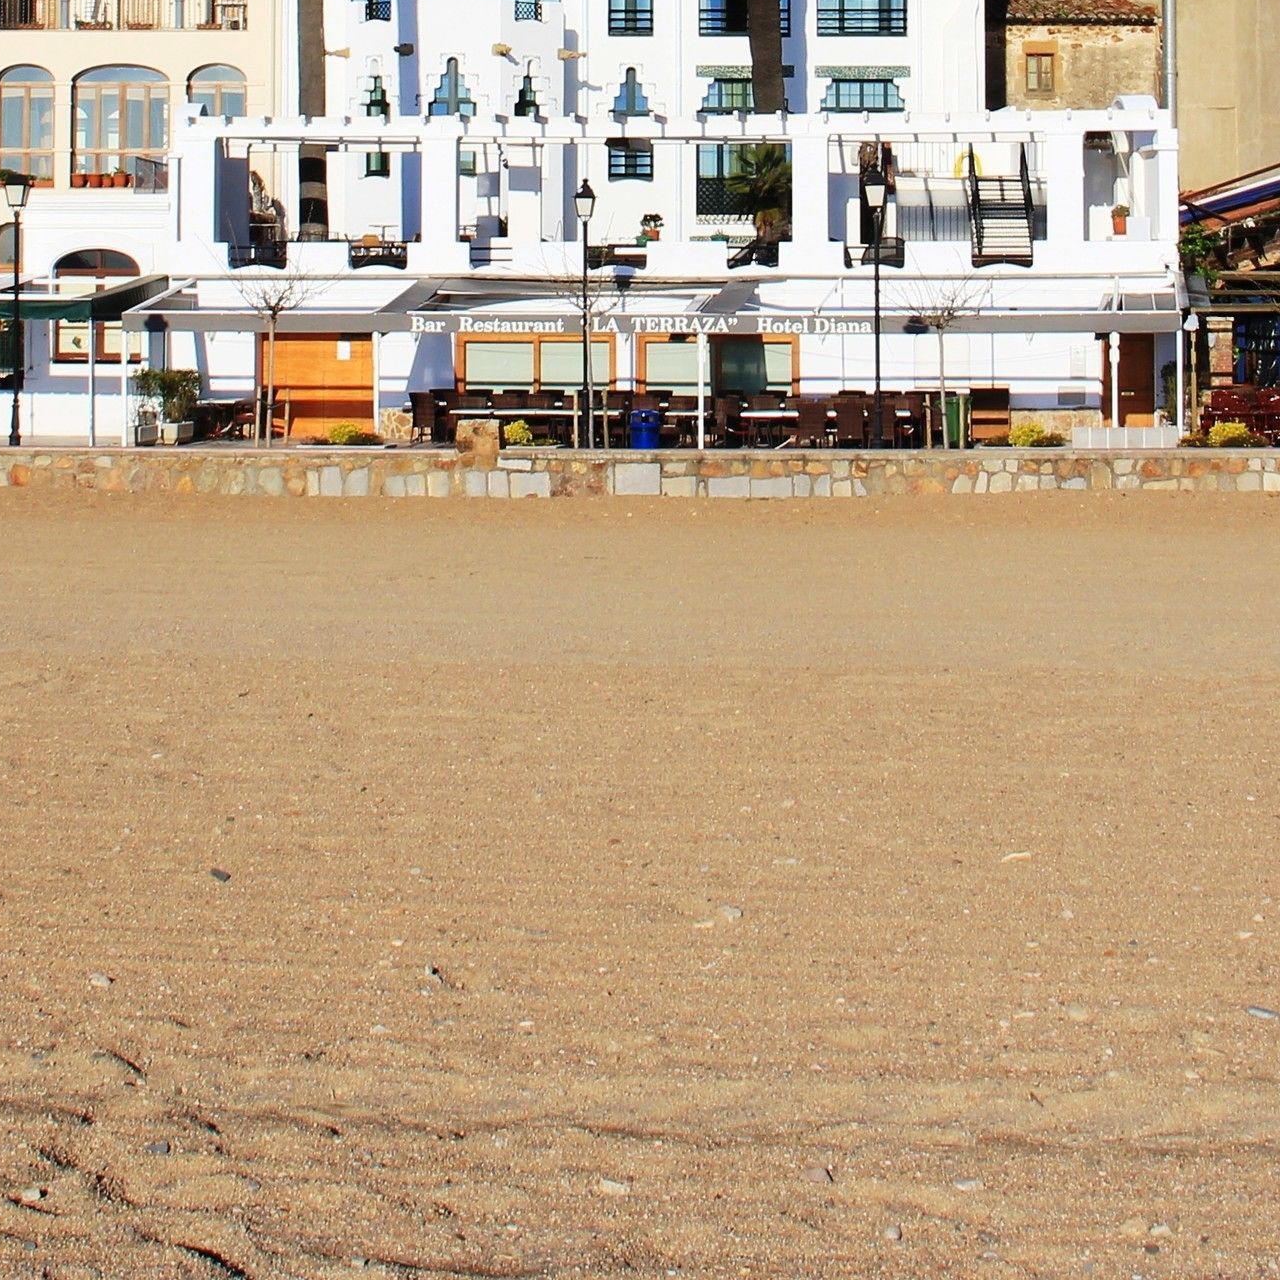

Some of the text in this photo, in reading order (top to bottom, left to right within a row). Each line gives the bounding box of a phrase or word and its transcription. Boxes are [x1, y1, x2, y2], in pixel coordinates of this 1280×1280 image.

[411, 316, 446, 332] Bar
[459, 316, 565, 332] Restaurant
[757, 317, 809, 333] Hotel
[814, 317, 872, 333] Diana
